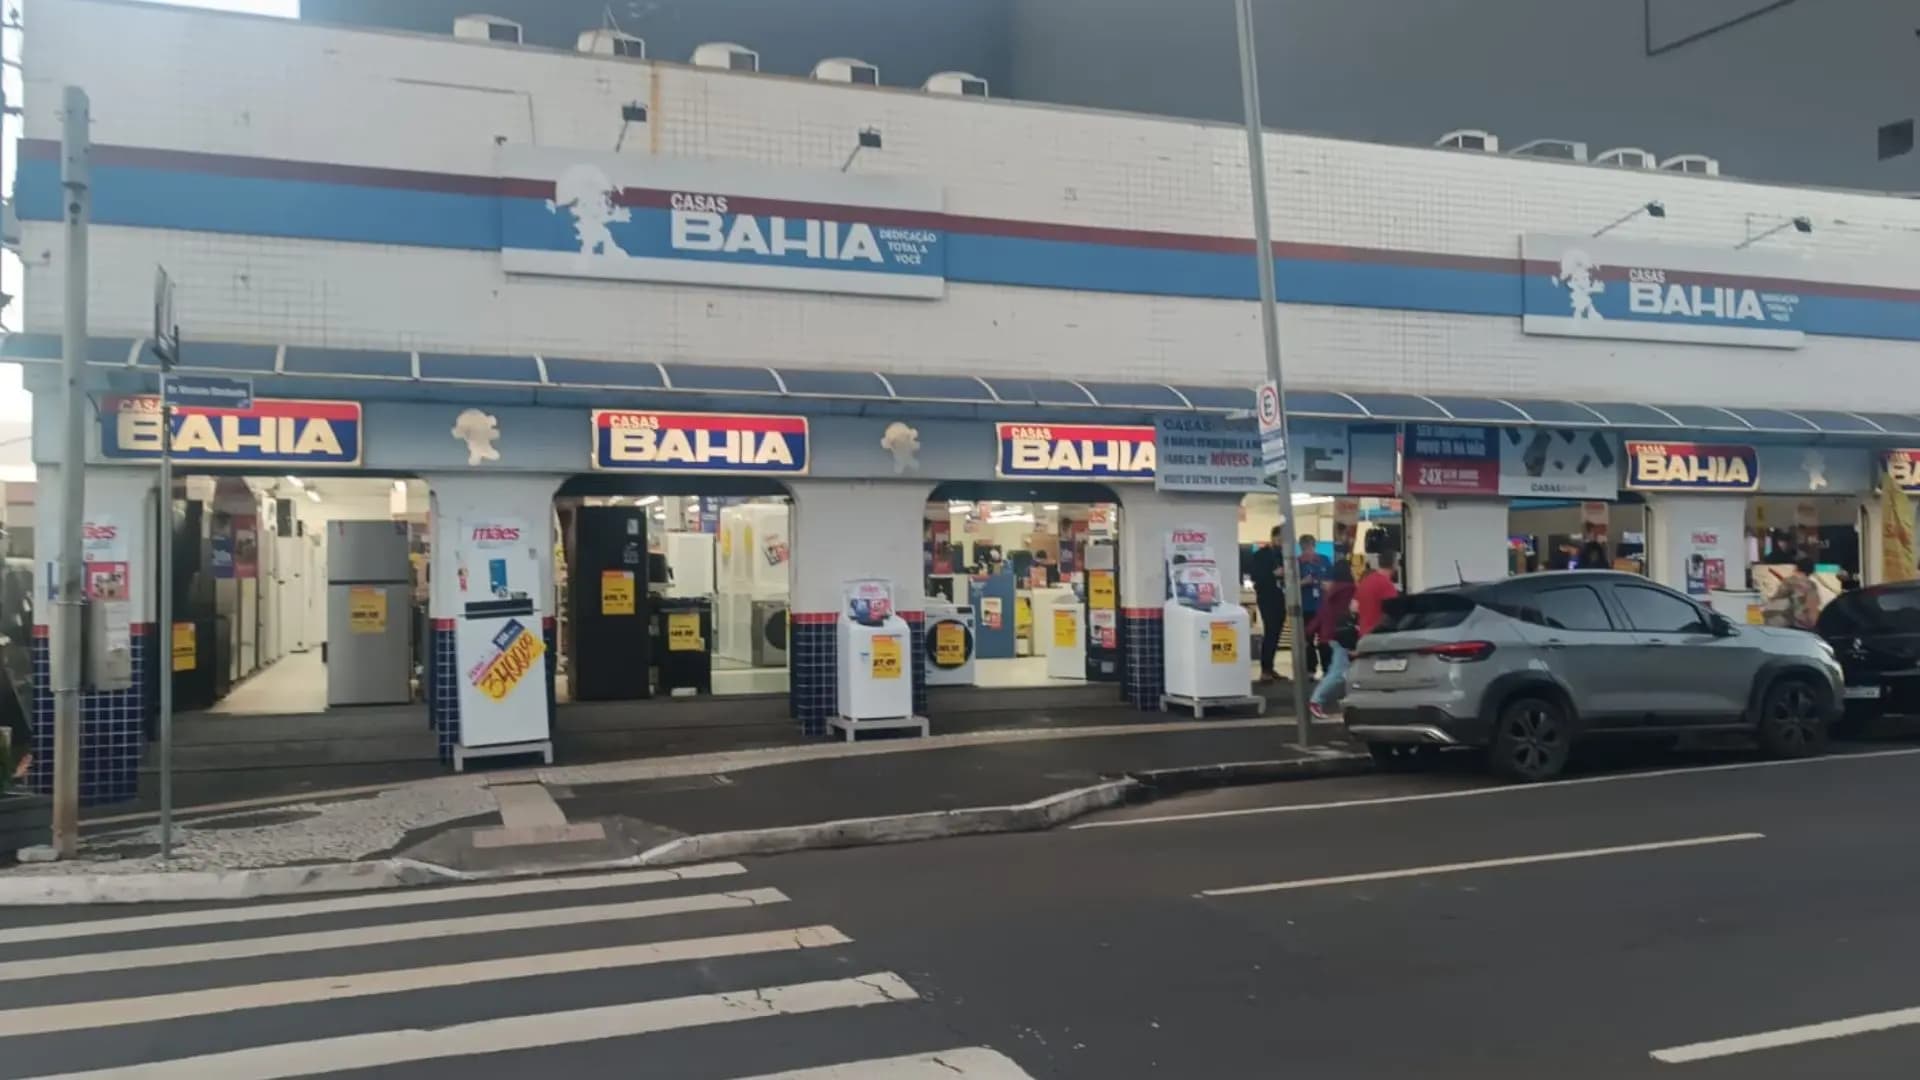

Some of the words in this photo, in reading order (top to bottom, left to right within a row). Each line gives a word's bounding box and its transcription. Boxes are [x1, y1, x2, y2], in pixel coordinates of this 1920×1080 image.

[671, 193, 728, 213] CASAS
[671, 210, 884, 264] BAHIA
[1629, 268, 1665, 284] CASAS
[1629, 282, 1765, 321] BAHIA
[117, 412, 343, 455] BAHIA
[609, 415, 659, 430] CASAS
[1011, 426, 1052, 440] CASAS
[610, 428, 795, 465] BAHIA
[1419, 468, 1442, 485] 24X
[1638, 454, 1749, 483] BAHIA
